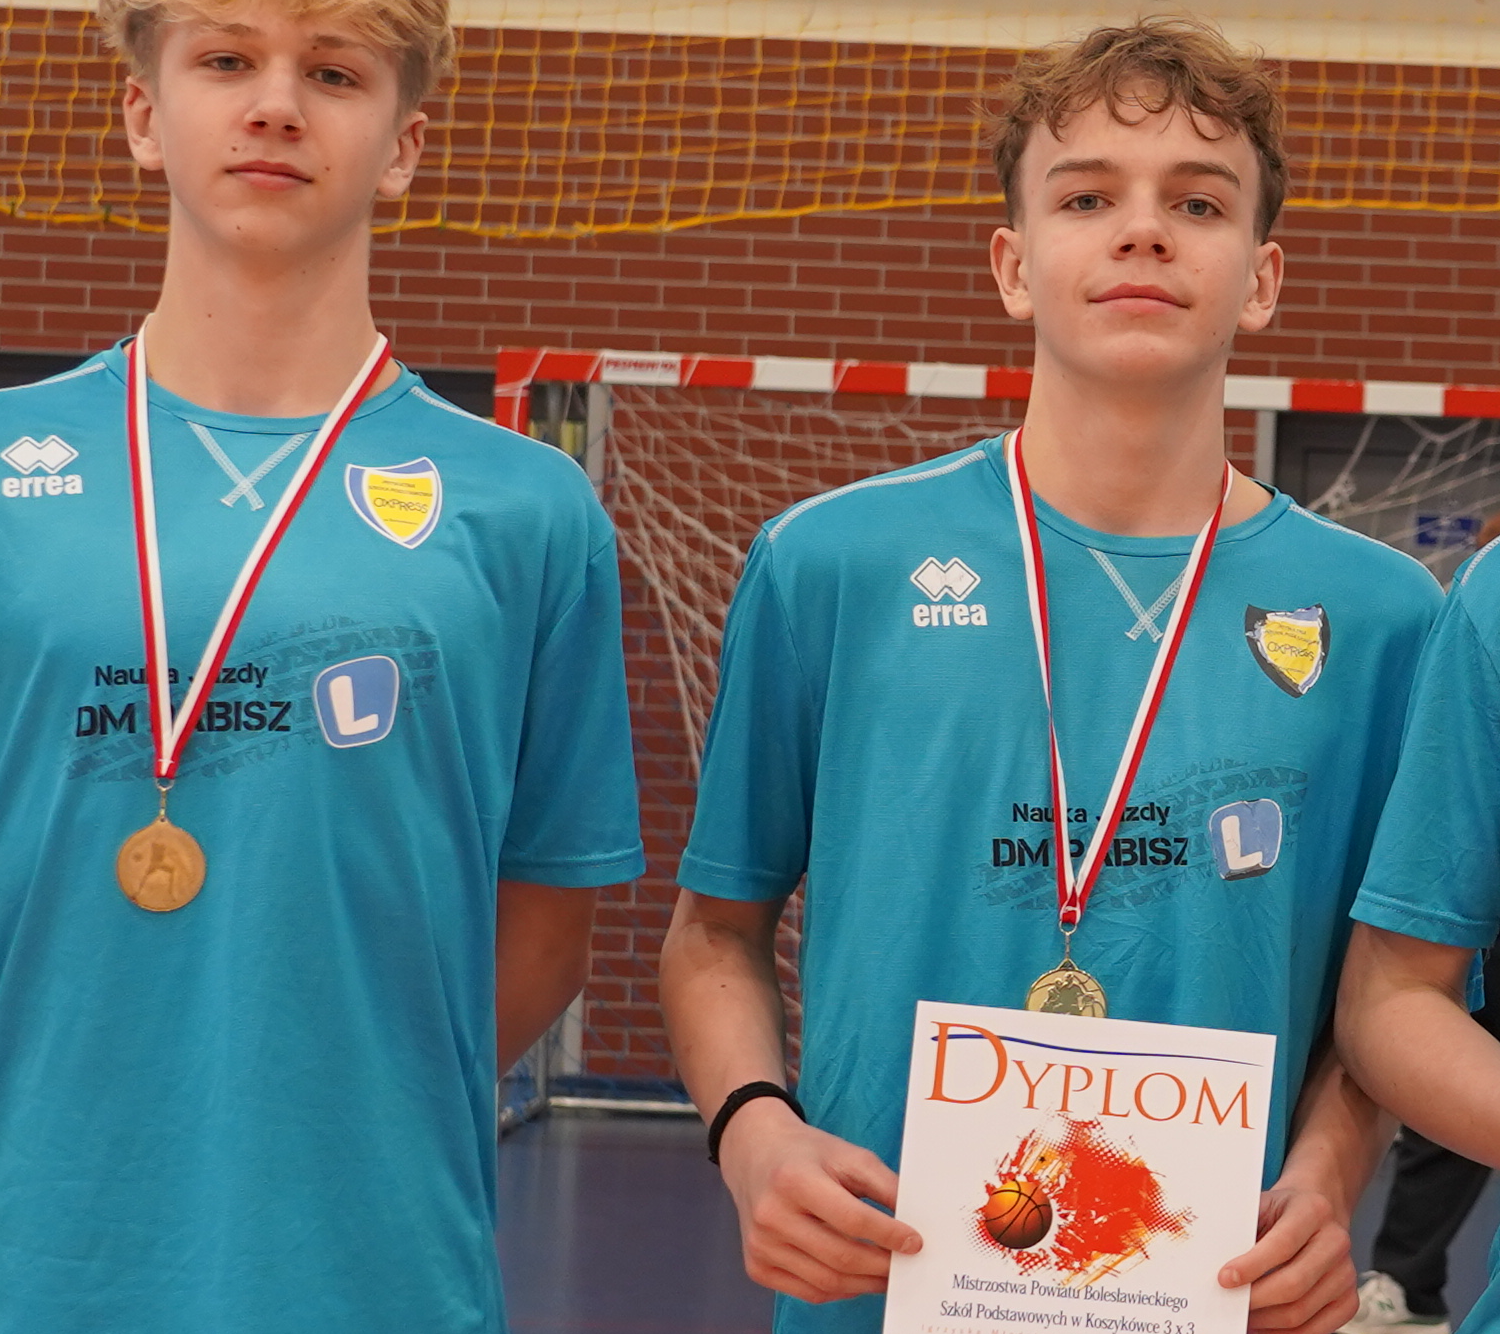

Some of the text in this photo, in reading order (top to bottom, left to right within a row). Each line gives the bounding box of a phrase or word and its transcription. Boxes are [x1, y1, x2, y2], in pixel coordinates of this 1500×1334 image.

[95, 664, 179, 687] Naua
[75, 701, 292, 737] DM BISZ
[992, 838, 1050, 867] DM
[924, 1020, 1256, 1130] DYPLOM
[952, 1273, 1189, 1313] Mistrzostwa Powiatu Bolesławieckiego
[940, 1299, 973, 1318] Szkół
[976, 1303, 1067, 1330] Podstawowych
[1071, 1315, 1082, 1327] w
[1085, 1312, 1160, 1334] Koszykówce
[1163, 1319, 1172, 1334] 3
